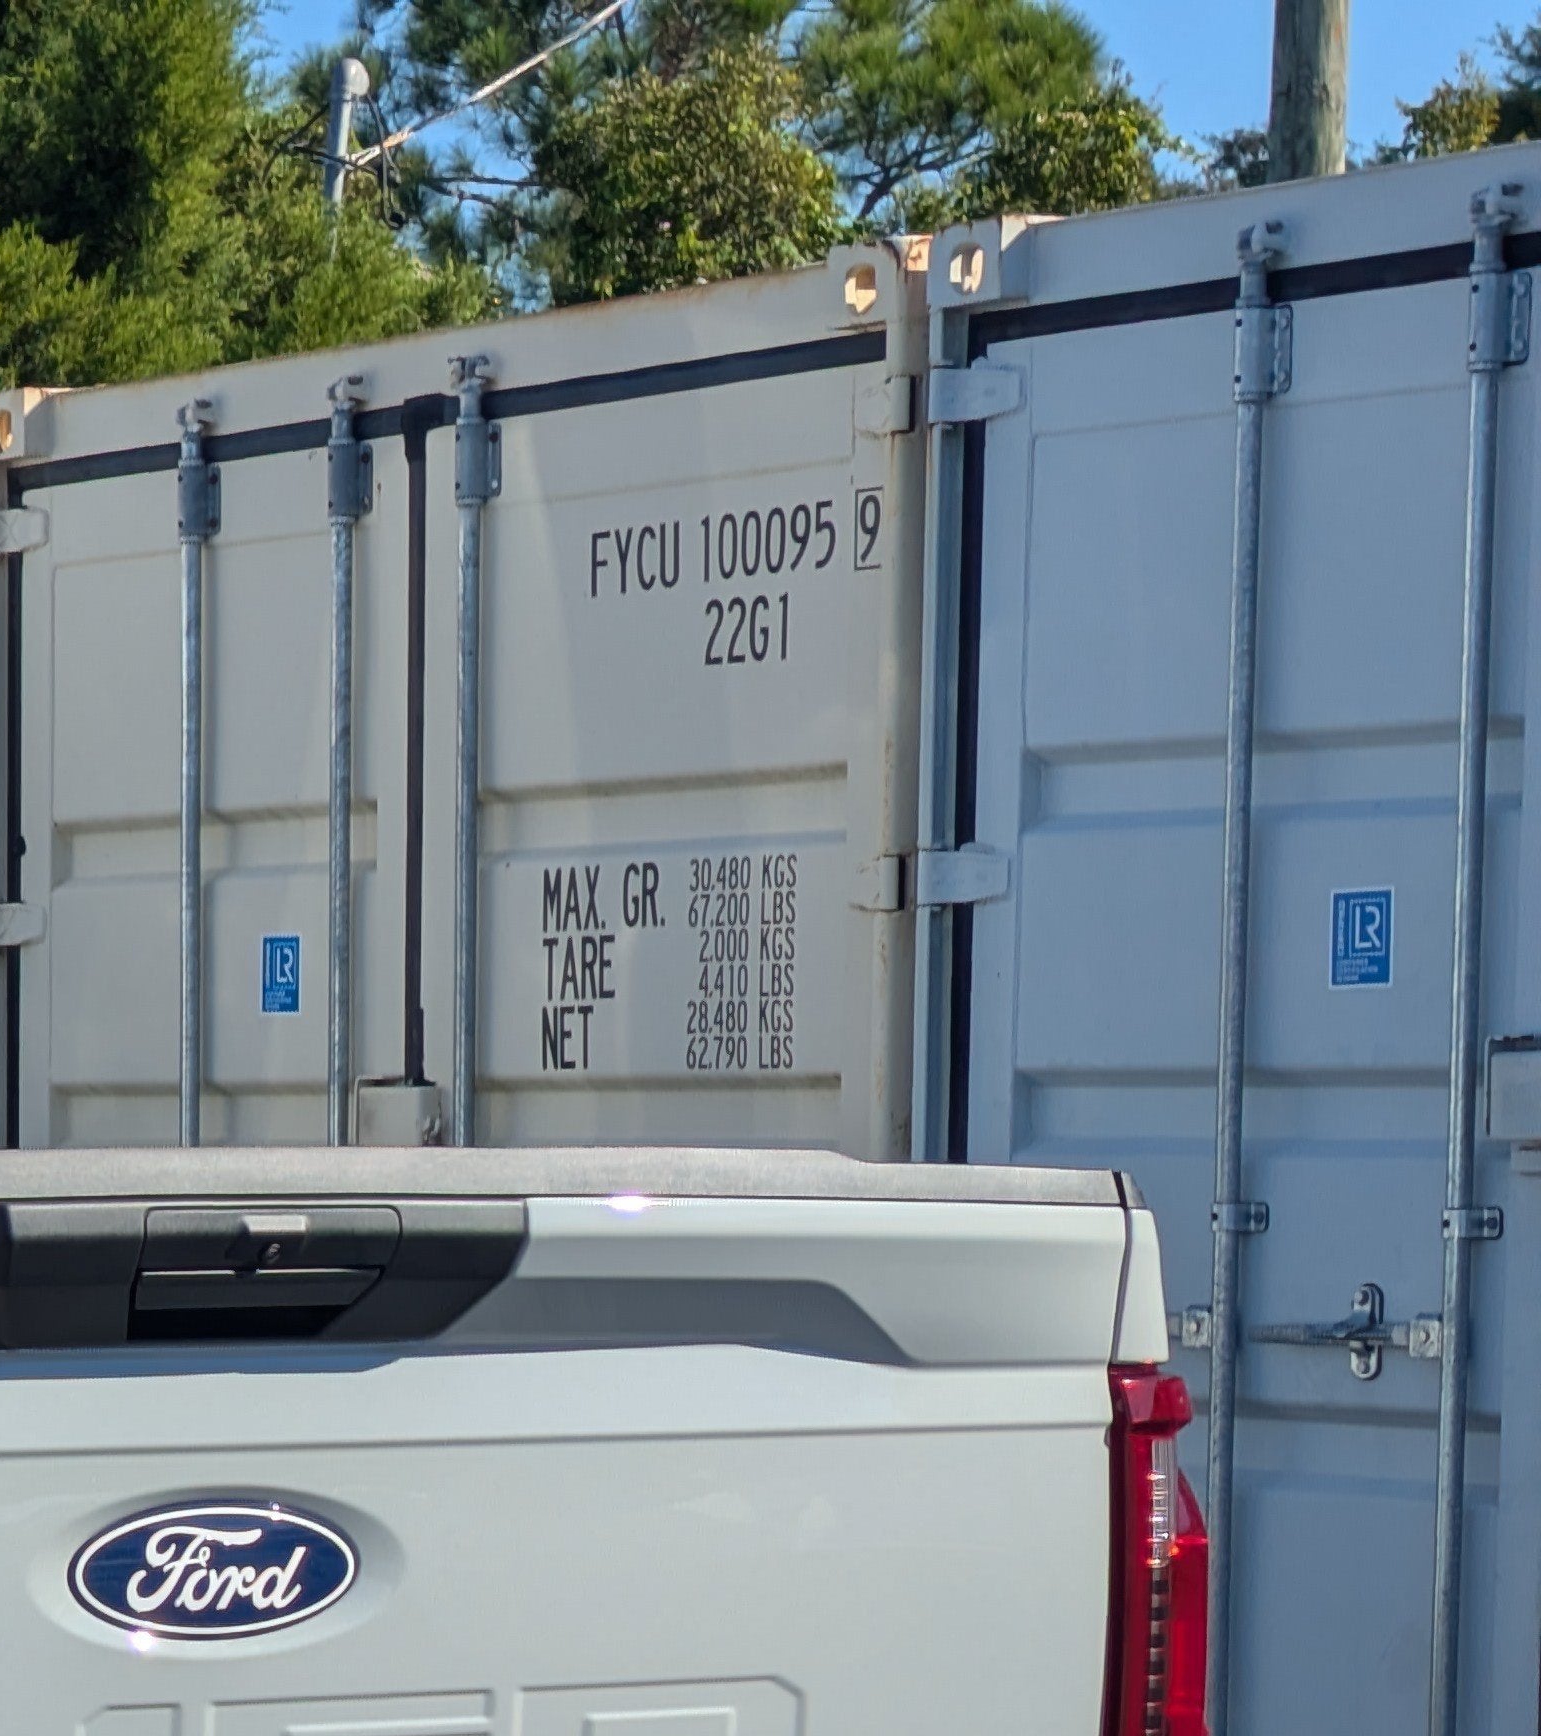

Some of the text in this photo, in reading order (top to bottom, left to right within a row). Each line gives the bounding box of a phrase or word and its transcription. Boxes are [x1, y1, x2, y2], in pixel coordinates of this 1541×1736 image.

[590, 494, 882, 598] FYCU 100095 9
[704, 592, 789, 665] 22G1
[761, 854, 797, 889] KGS
[542, 862, 666, 933] MAX. GR.
[760, 890, 796, 925] LBS
[759, 926, 796, 962] KGS
[1355, 904, 1381, 949] LR
[276, 947, 294, 983] LR
[542, 934, 616, 1001] TARE
[759, 963, 795, 998] LBS
[758, 999, 794, 1034] KGS
[542, 1005, 594, 1071] NET
[758, 1035, 794, 1070] LBS
[126, 1525, 307, 1613] Ford
